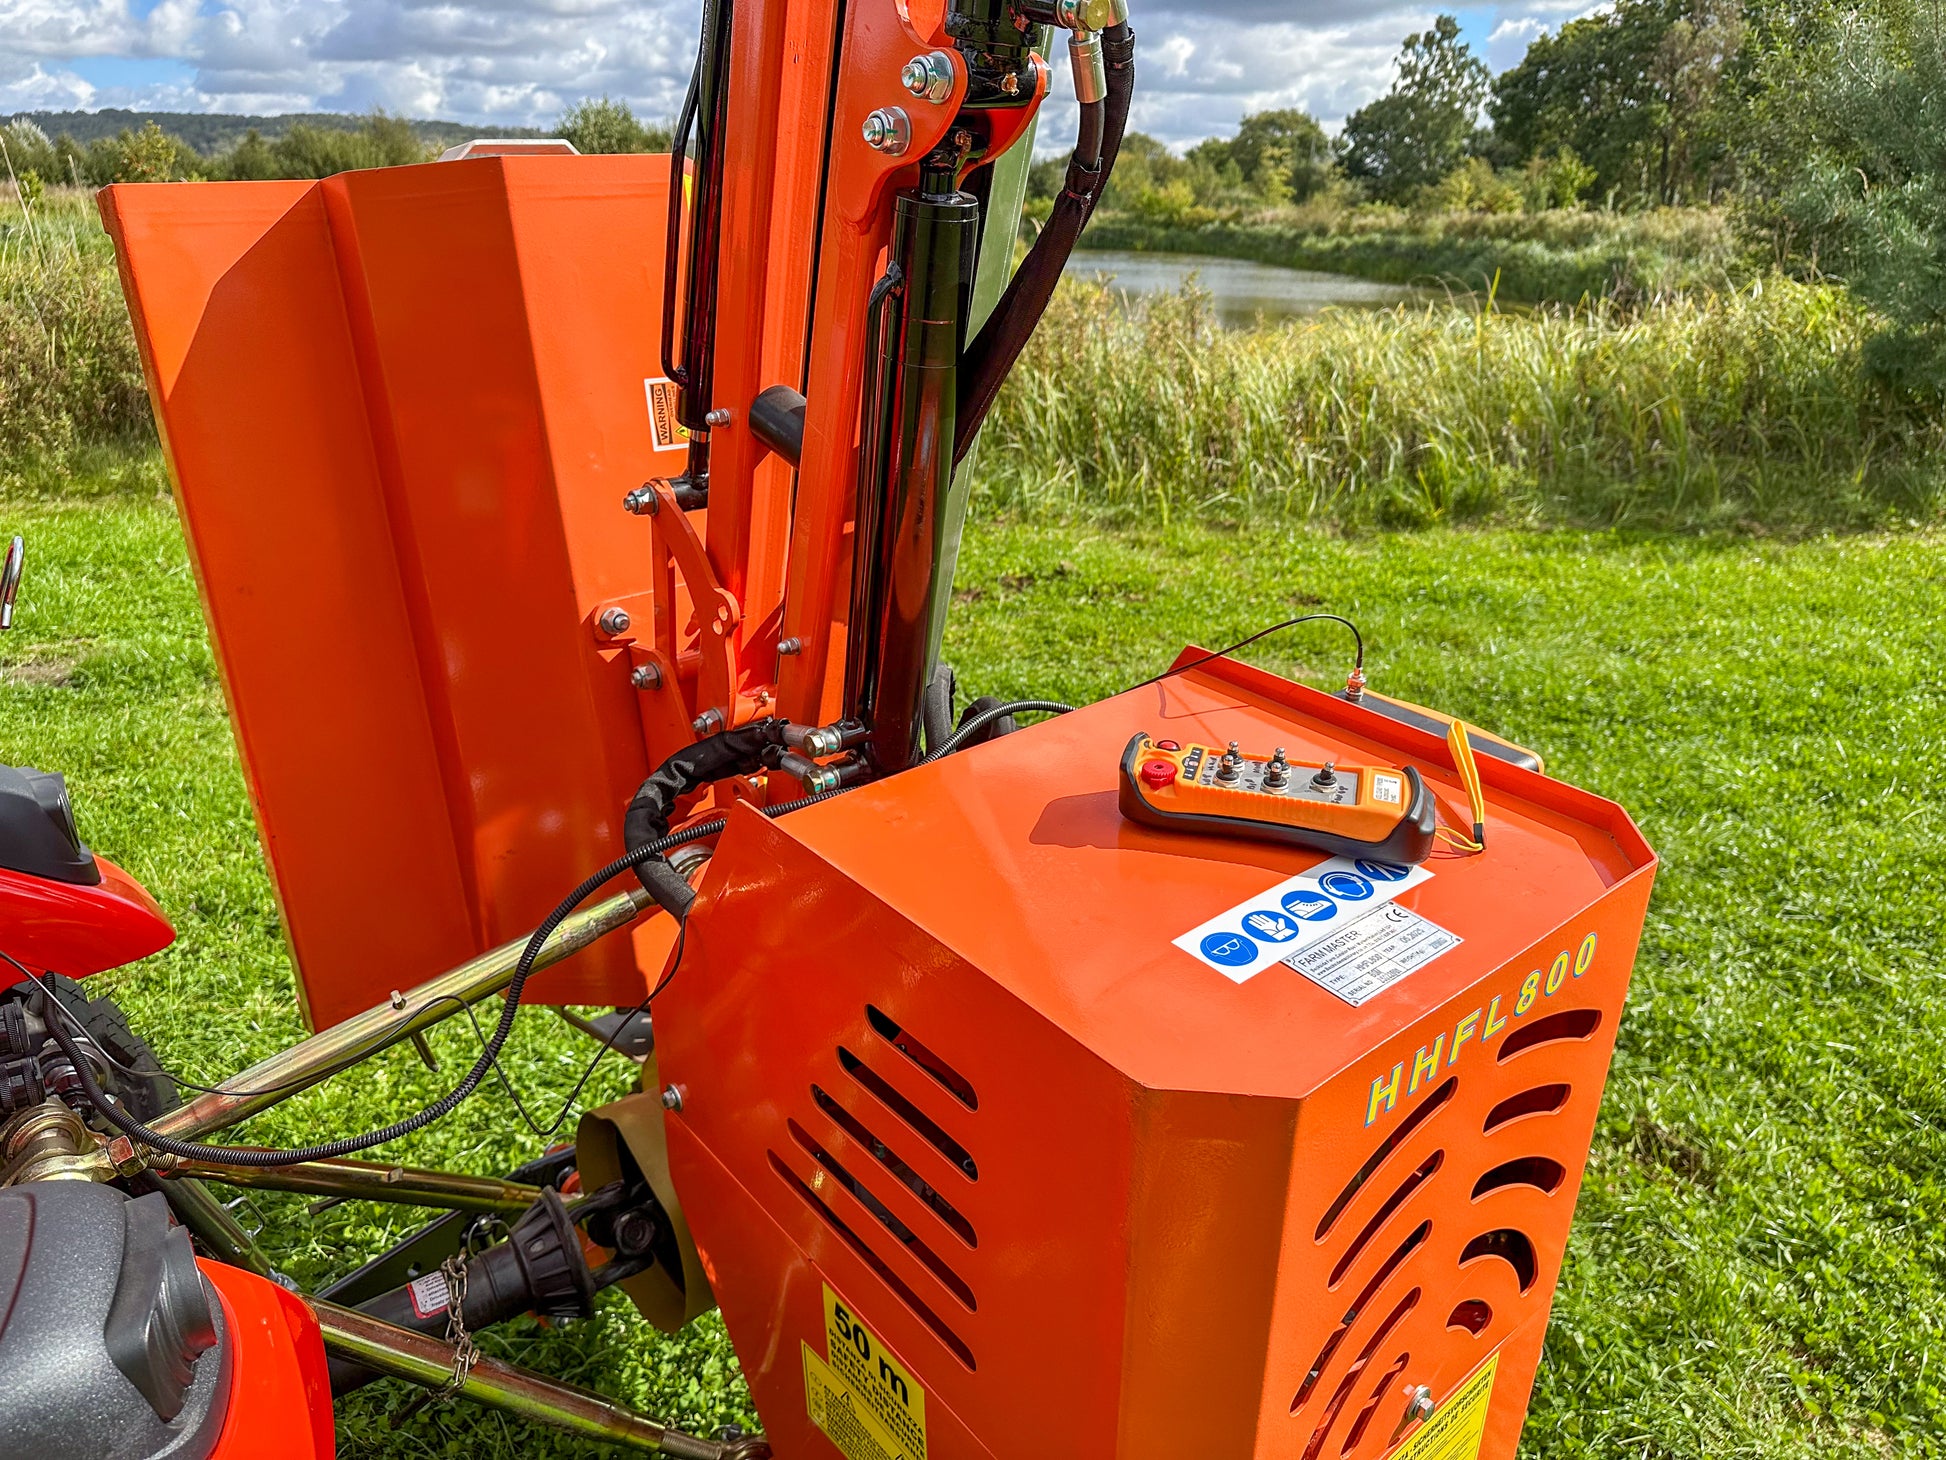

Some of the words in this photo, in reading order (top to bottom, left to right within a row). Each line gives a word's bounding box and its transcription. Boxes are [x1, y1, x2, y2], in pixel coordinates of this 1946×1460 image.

[655, 388, 668, 441] WARNING
[1298, 947, 1327, 967] FARM
[1326, 930, 1362, 953] MASTER
[829, 1327, 867, 1371] DISTANZA
[868, 1370, 876, 1383] DI
[878, 1381, 924, 1437] SICUREZZA
[834, 1301, 871, 1361] 50
[879, 1355, 909, 1406] m
[830, 1338, 870, 1384] SAFETY
[872, 1384, 925, 1450] DISTANCE
[1450, 1412, 1459, 1425] DE
